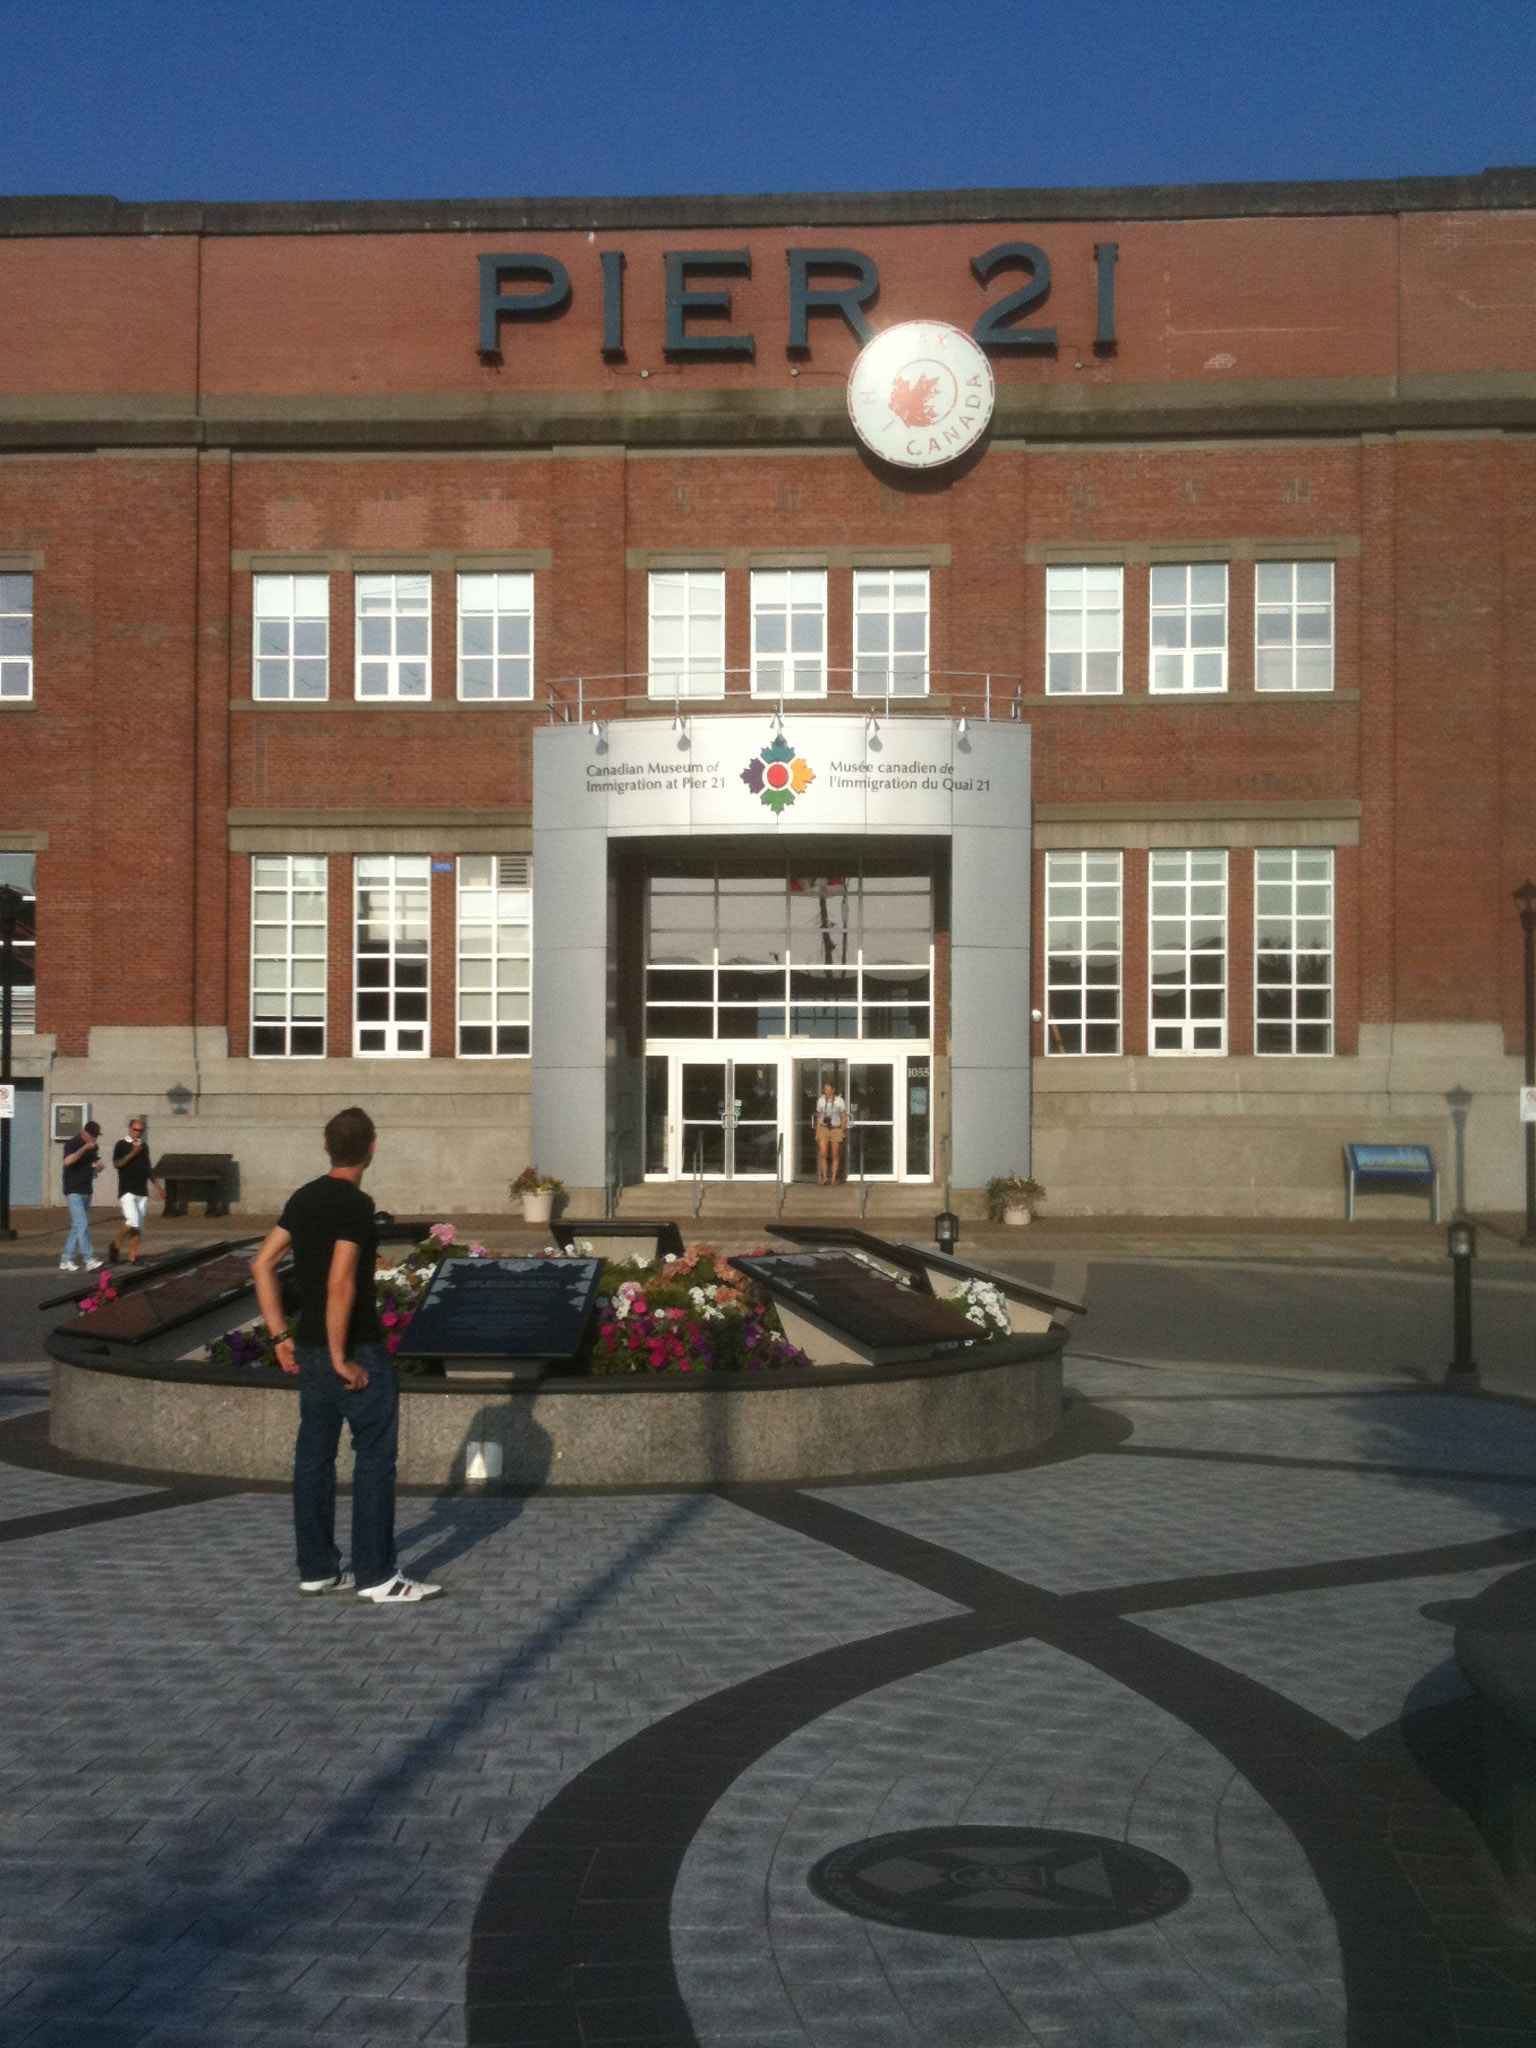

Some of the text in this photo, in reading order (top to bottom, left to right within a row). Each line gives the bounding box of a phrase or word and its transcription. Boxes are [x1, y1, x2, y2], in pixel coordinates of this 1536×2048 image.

[477, 241, 1119, 360] PIER 21
[905, 373, 982, 456] CANADA
[586, 761, 720, 777] Canadian Museum of
[829, 760, 955, 775] Musée canadien de
[586, 776, 725, 795] Immigration at Pier 21
[829, 776, 990, 793] l'immigration du Quai 21
[908, 1067, 929, 1077] 1055
